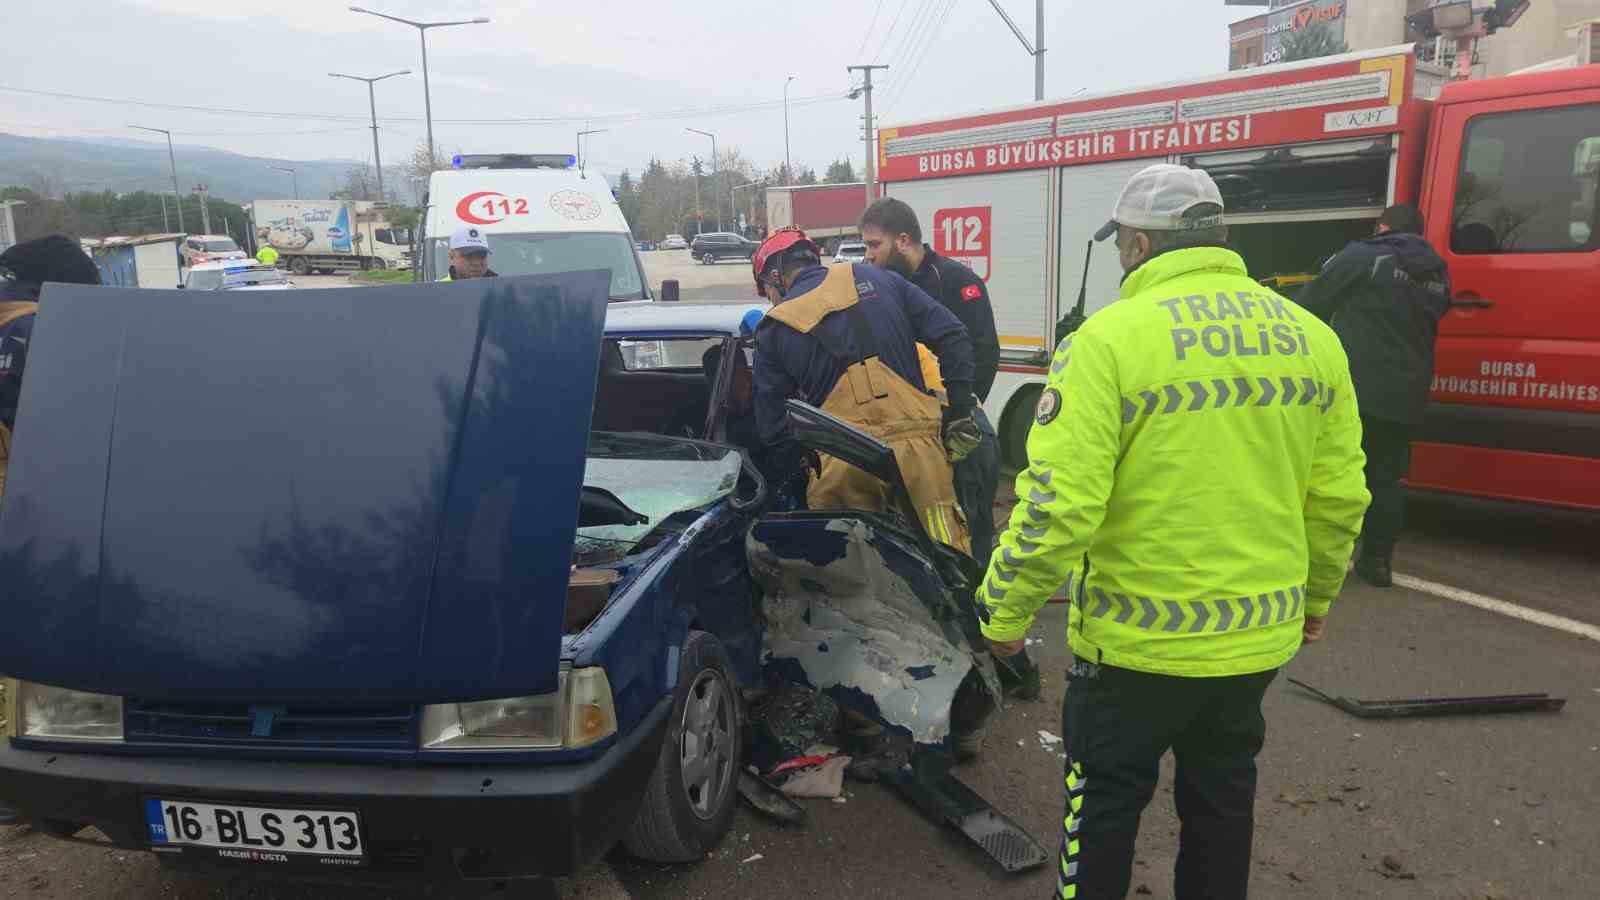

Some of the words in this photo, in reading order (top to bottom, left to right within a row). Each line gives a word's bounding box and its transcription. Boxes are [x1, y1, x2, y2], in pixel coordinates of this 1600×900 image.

[919, 152, 976, 173] BURSA
[986, 134, 1115, 166] BÜYÜKŞEHİR
[1129, 115, 1251, 151] İTFAİYESİ
[482, 198, 529, 216] 112
[942, 216, 982, 251] 112
[1157, 292, 1297, 323] TRAFİK
[1170, 323, 1310, 361] POLİSİ
[1480, 361, 1536, 378] BURSA
[1430, 373, 1518, 396] ÜYÜKŞEHİR
[1523, 379, 1600, 402] İTFAİYES
[151, 824, 165, 834] TR
[165, 805, 203, 841] 16
[214, 808, 285, 847] BLS
[293, 814, 358, 851] 313
